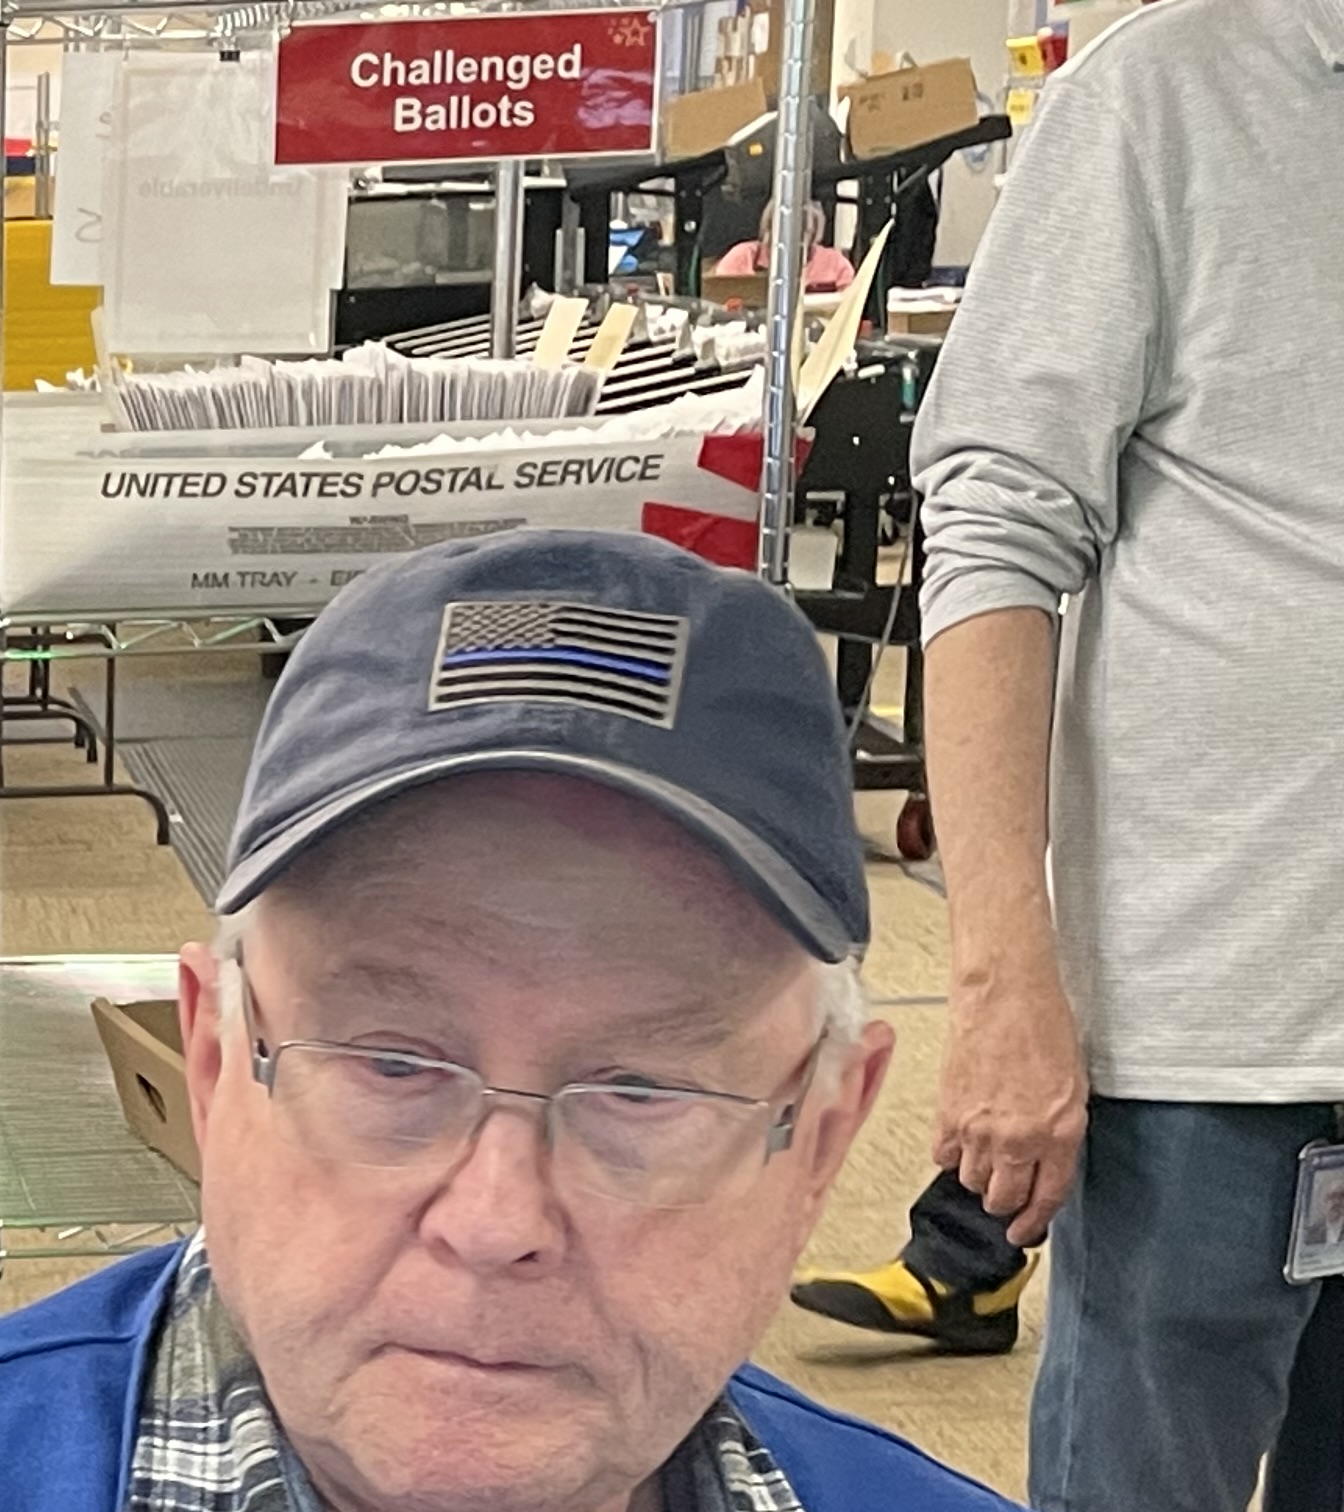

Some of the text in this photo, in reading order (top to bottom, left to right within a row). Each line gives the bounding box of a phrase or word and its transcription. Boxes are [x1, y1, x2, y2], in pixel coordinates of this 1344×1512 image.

[350, 43, 582, 90] Challenged
[393, 96, 536, 132] Ballots
[101, 454, 664, 498] UNITED STATES POSTAL SERVICE
[191, 572, 229, 588] MM
[237, 571, 298, 588] TRAY
